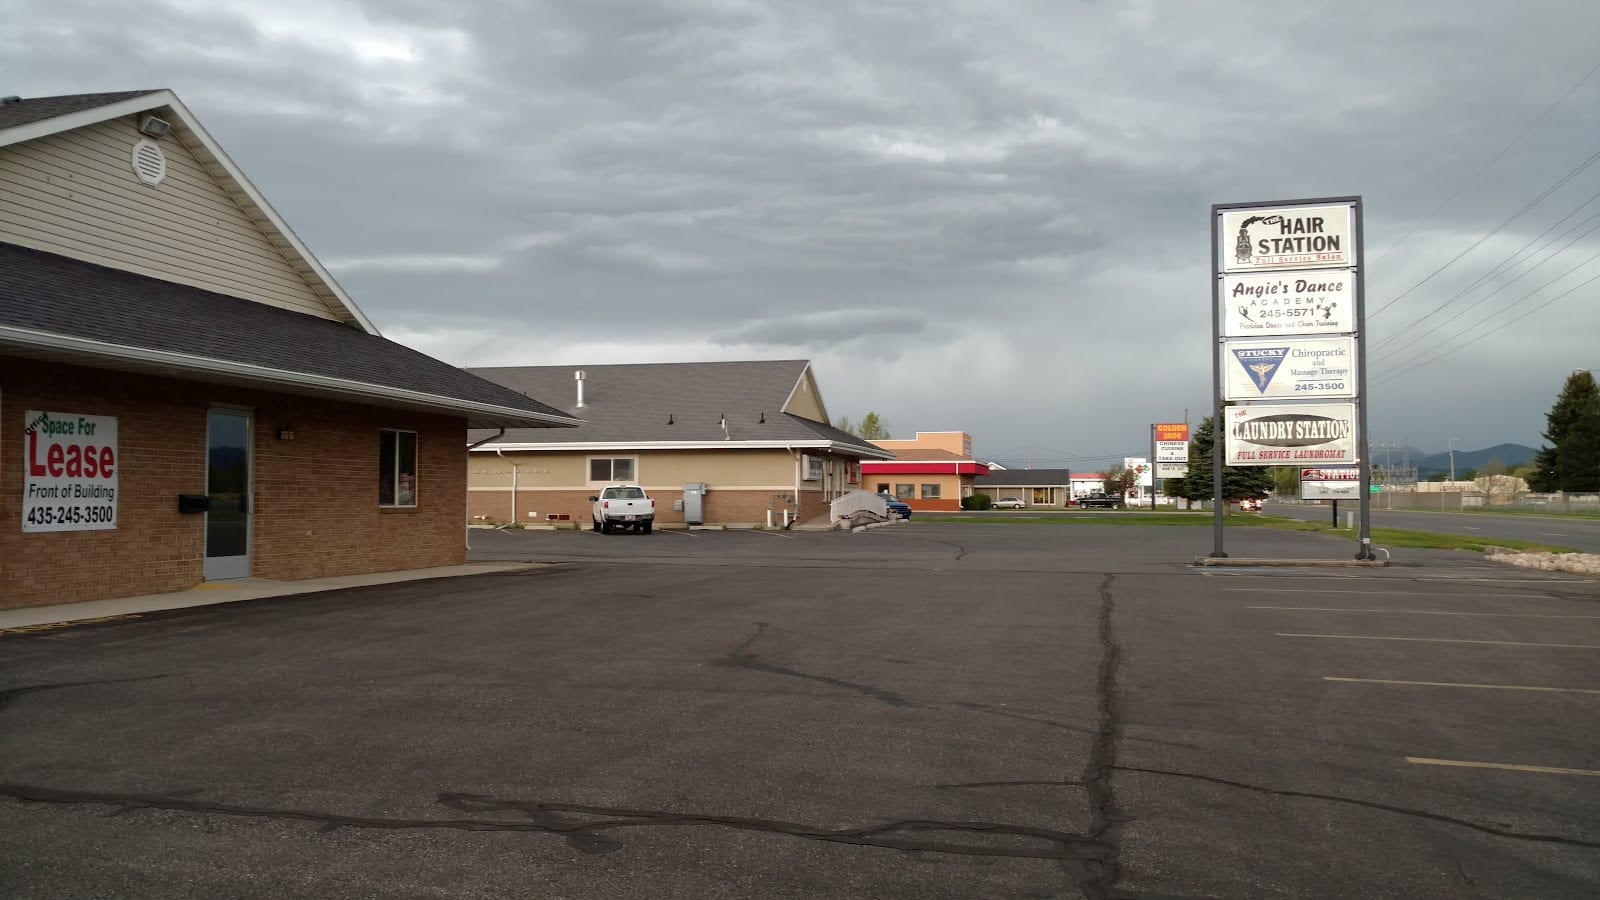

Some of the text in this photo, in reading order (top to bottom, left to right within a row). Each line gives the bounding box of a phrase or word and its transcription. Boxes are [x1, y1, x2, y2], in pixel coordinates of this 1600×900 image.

[1263, 216, 1281, 225] THE
[1280, 217, 1324, 234] HAIR
[1258, 235, 1340, 254] STATION
[1279, 255, 1312, 263] Service
[1232, 279, 1343, 298] Angie's Dance
[1250, 297, 1326, 306] ACADEMY
[1259, 308, 1314, 318] 245-5571
[1237, 348, 1285, 357] STUCKY
[1292, 347, 1346, 360] Chiropractic
[1290, 367, 1348, 378] Massage Therapy
[1294, 382, 1345, 391] 245-3500
[1234, 410, 1247, 418] THE
[42, 418, 96, 438] Space For
[1234, 420, 1350, 440] LAUNDRY STATION
[30, 431, 114, 478] Lease
[1237, 450, 1346, 460] FULL SERVICE LAUNDROMAT
[29, 484, 114, 502] Front of Building
[28, 506, 113, 525] 435-245-3500
